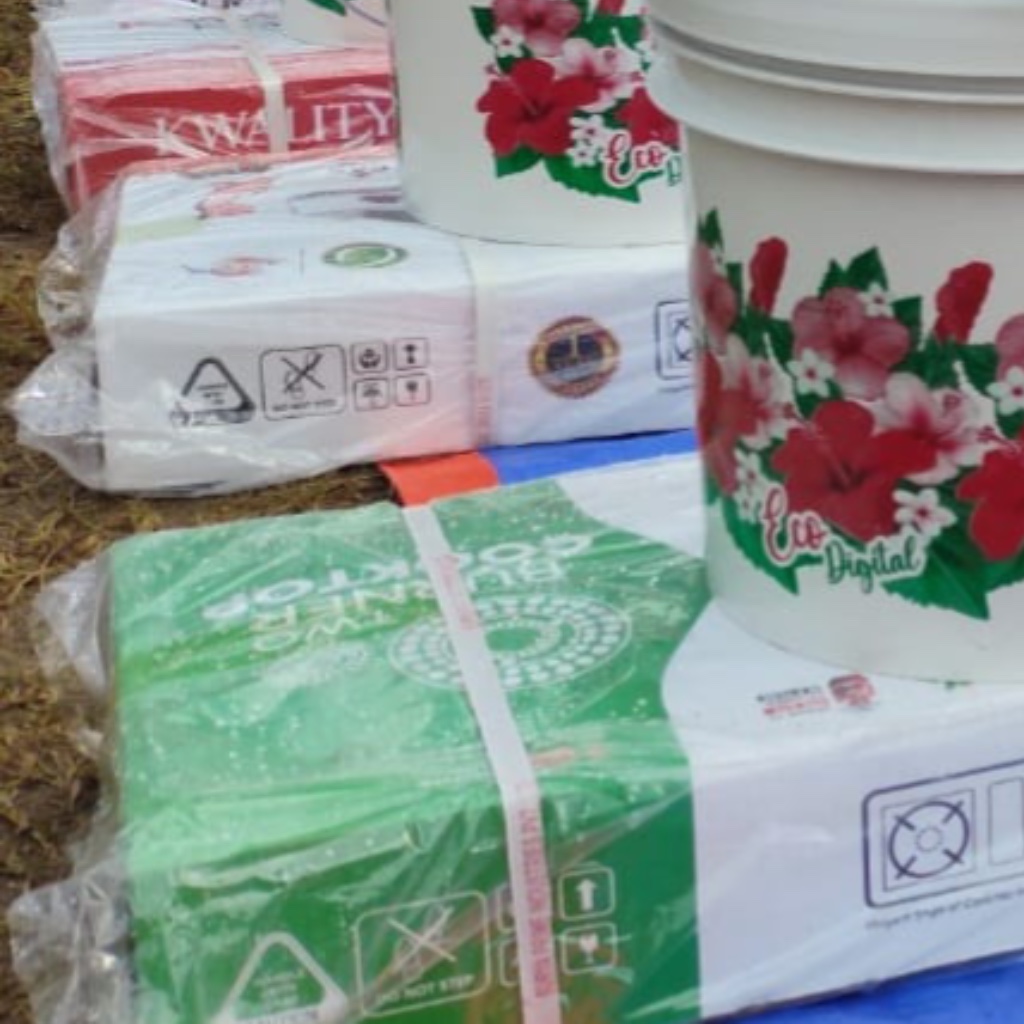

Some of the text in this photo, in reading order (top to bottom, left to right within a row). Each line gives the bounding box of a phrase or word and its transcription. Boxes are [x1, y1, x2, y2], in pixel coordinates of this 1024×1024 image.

[605, 132, 668, 185] Eco
[764, 486, 827, 562] Eco
[825, 536, 920, 594] Digital
